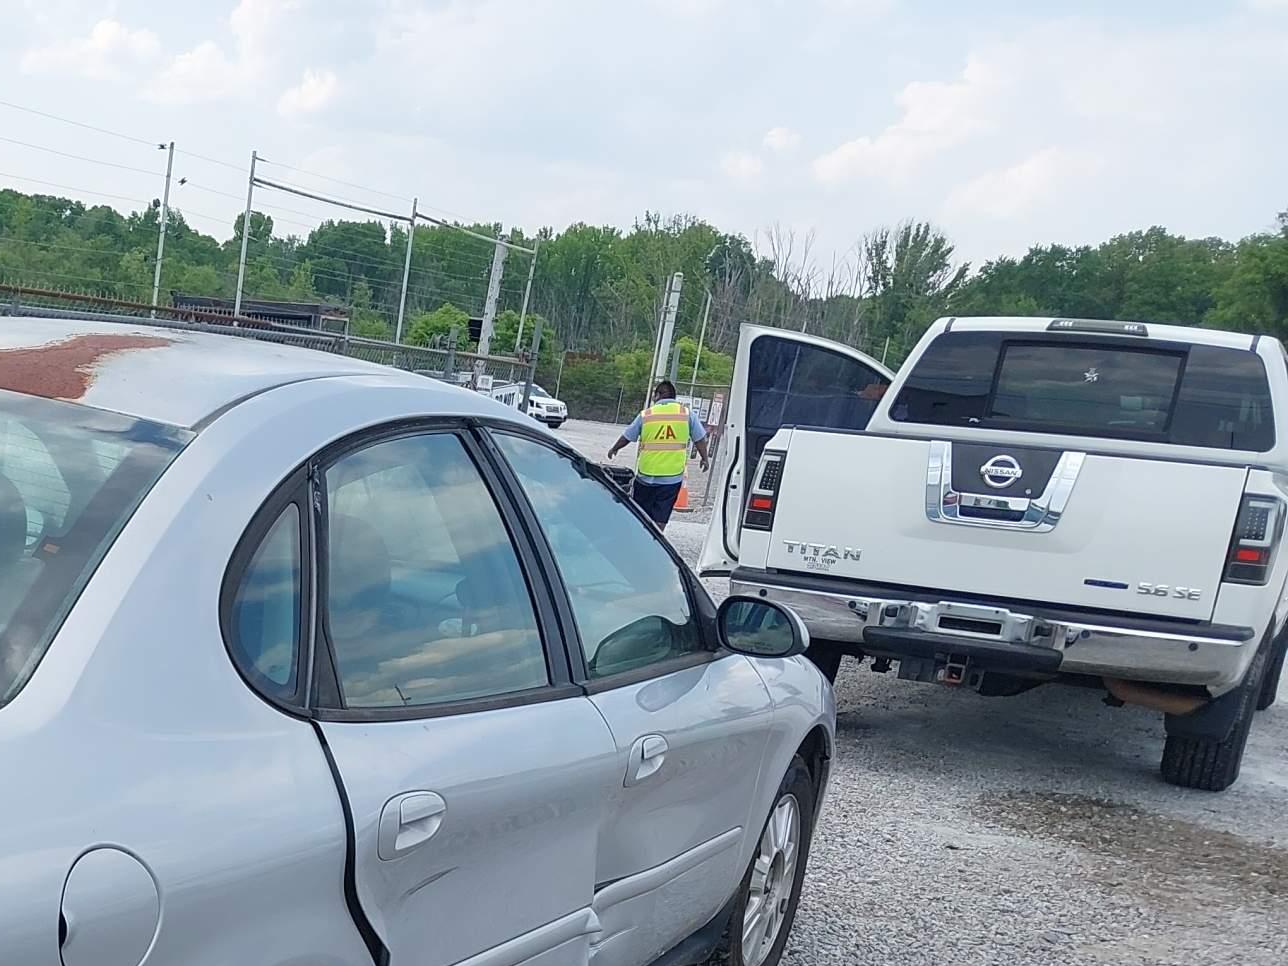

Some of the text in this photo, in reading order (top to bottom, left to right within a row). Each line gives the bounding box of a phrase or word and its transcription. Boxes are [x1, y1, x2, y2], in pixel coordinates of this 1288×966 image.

[985, 467, 1018, 476] NISSAN
[783, 539, 863, 561] TITAN
[1172, 586, 1202, 601] SE
